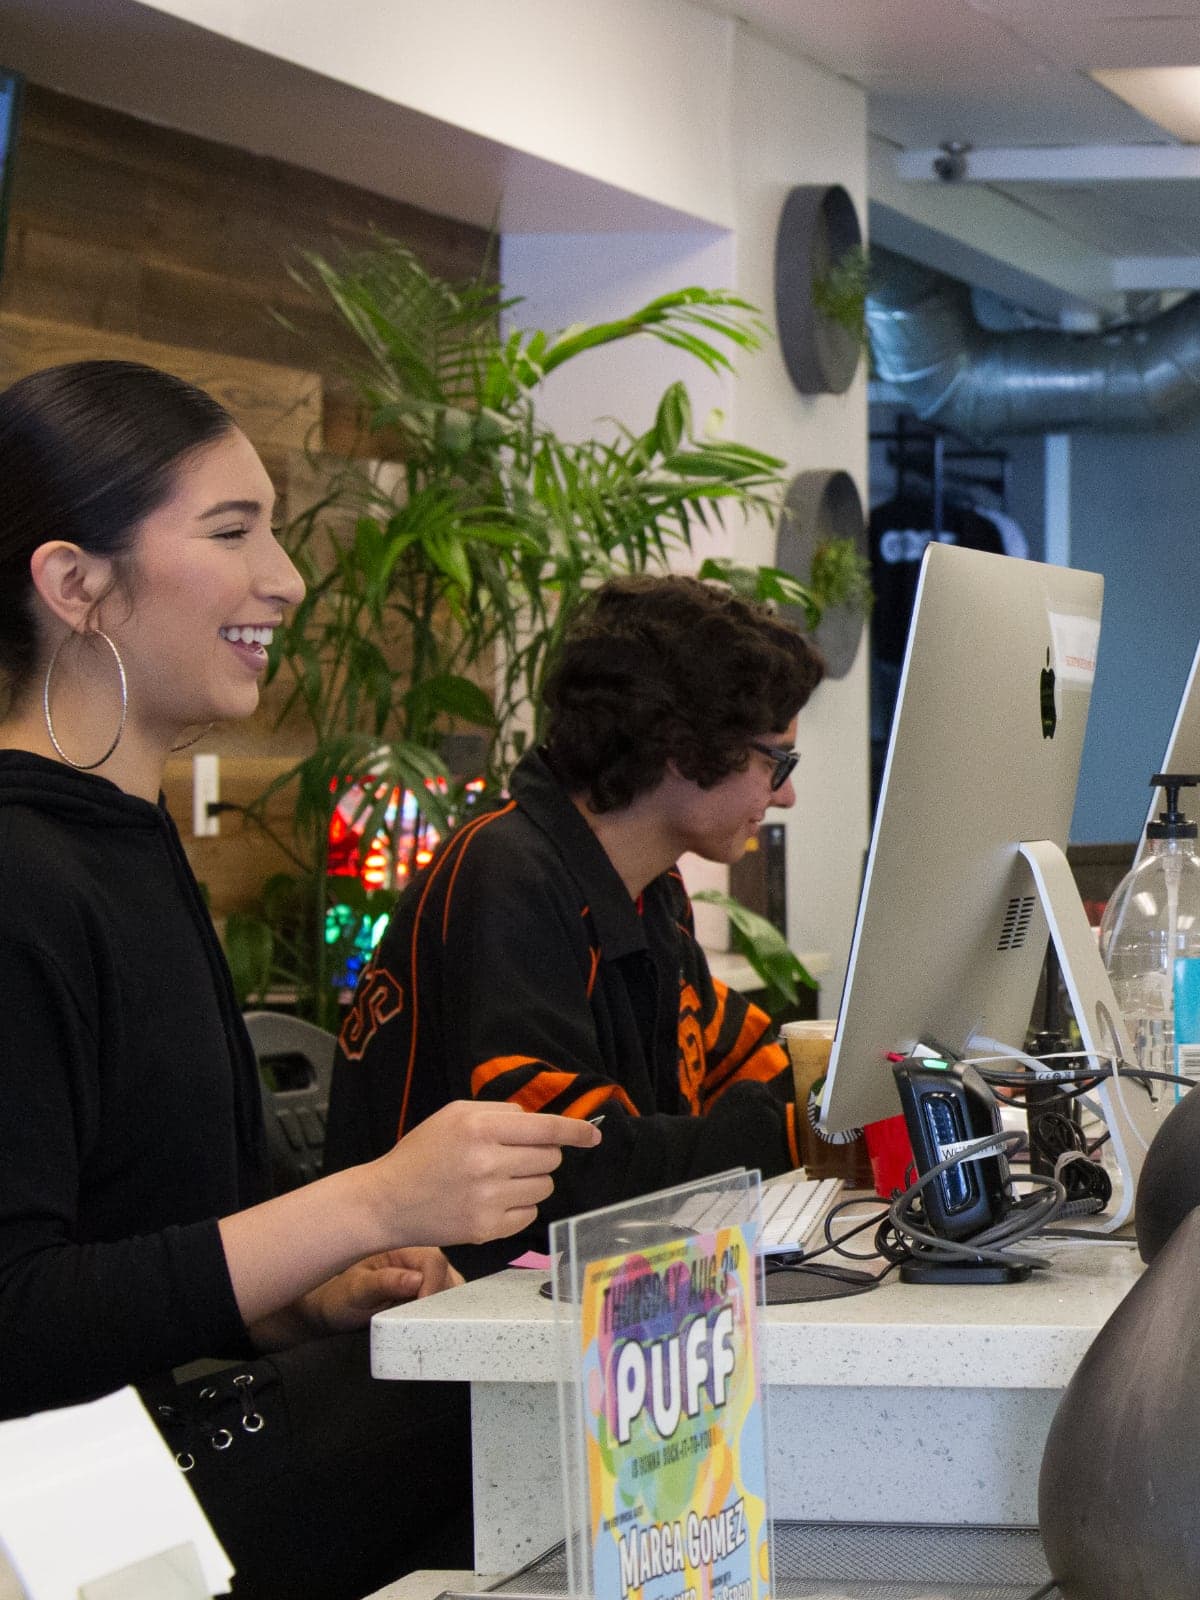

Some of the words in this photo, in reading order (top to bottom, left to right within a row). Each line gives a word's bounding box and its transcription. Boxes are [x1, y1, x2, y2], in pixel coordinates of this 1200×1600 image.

[614, 1305, 737, 1446] PUFF
[618, 1521, 685, 1600] MARGA
[687, 1496, 746, 1569] GOMEZ
